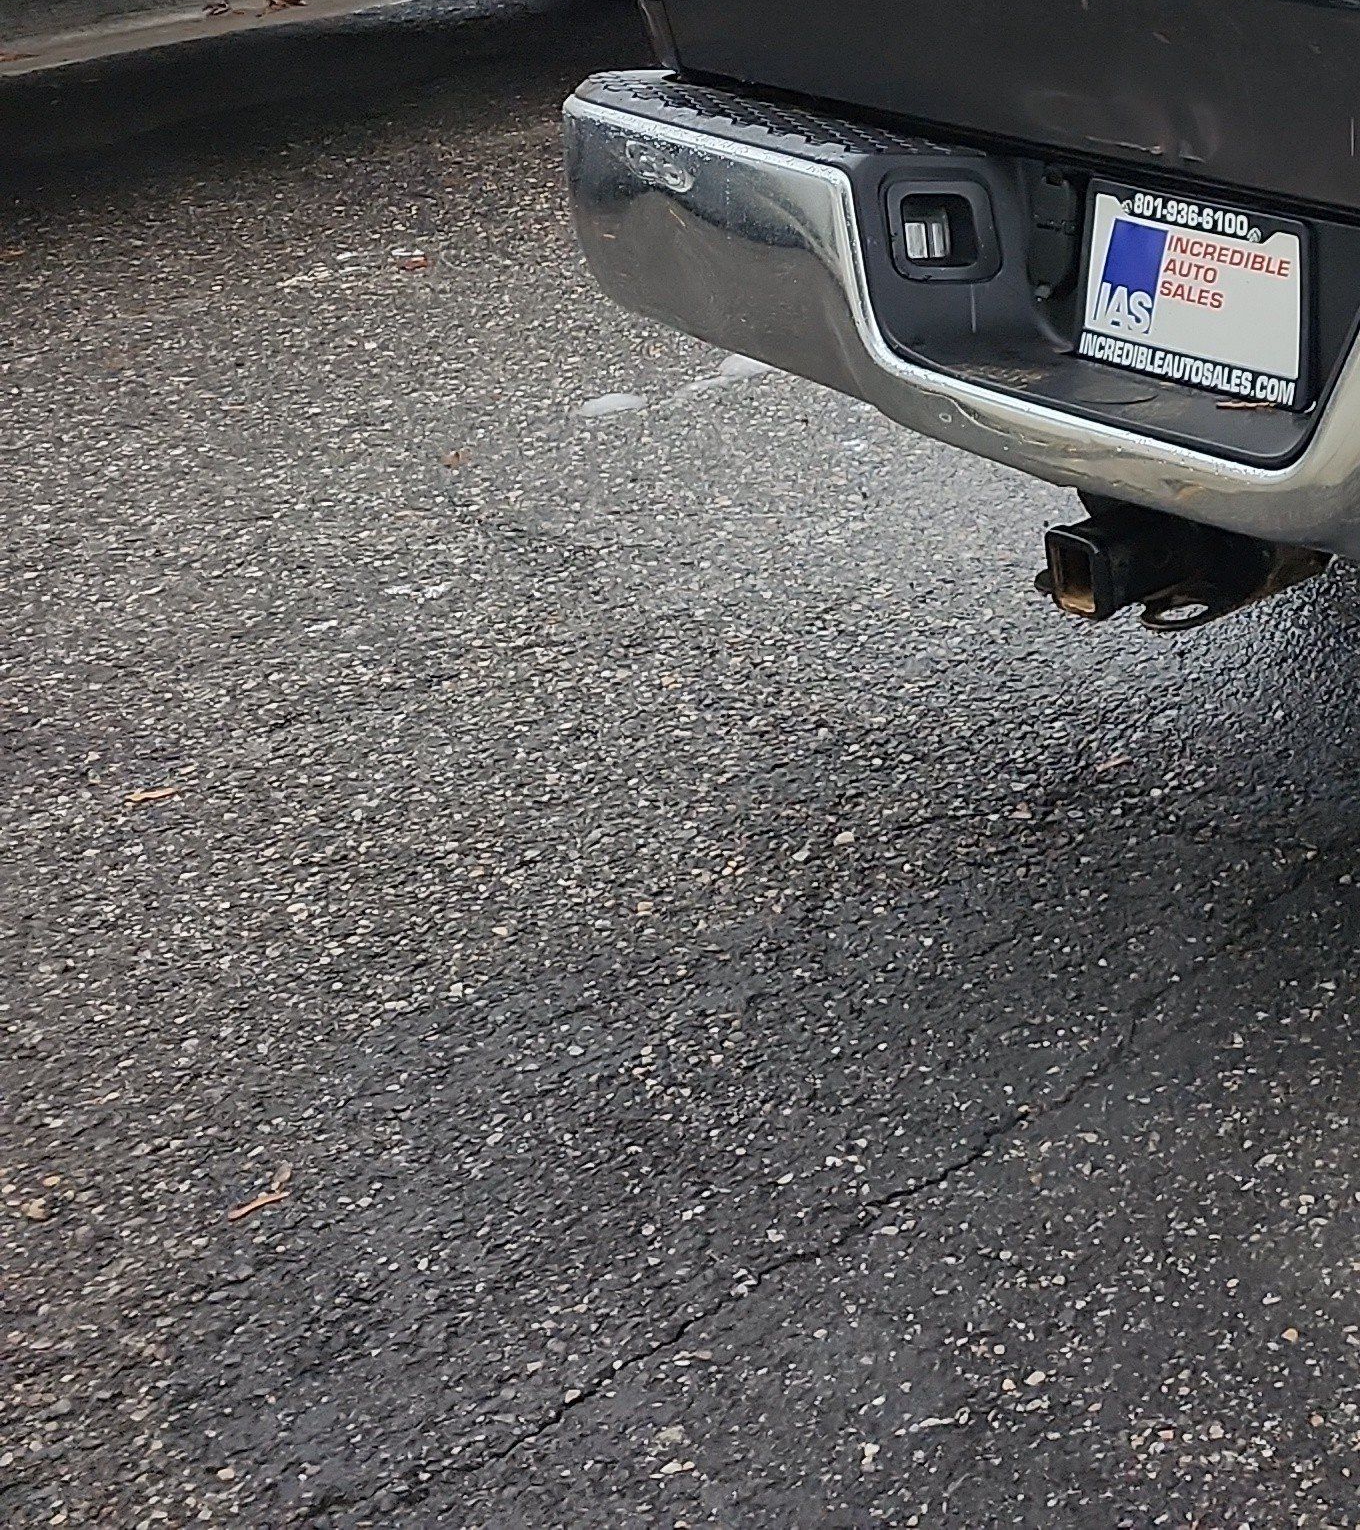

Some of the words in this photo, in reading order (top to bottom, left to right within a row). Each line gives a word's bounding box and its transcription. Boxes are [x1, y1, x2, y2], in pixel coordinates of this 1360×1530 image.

[1133, 193, 1248, 237] 801-936-6100
[1163, 258, 1218, 284] AUTO
[1167, 234, 1291, 277] INCREDIBLE
[1094, 281, 1154, 334] IAS
[1159, 280, 1224, 309] SALES
[1079, 331, 1296, 406] INCREDIBLEAUTOSALES.COM
